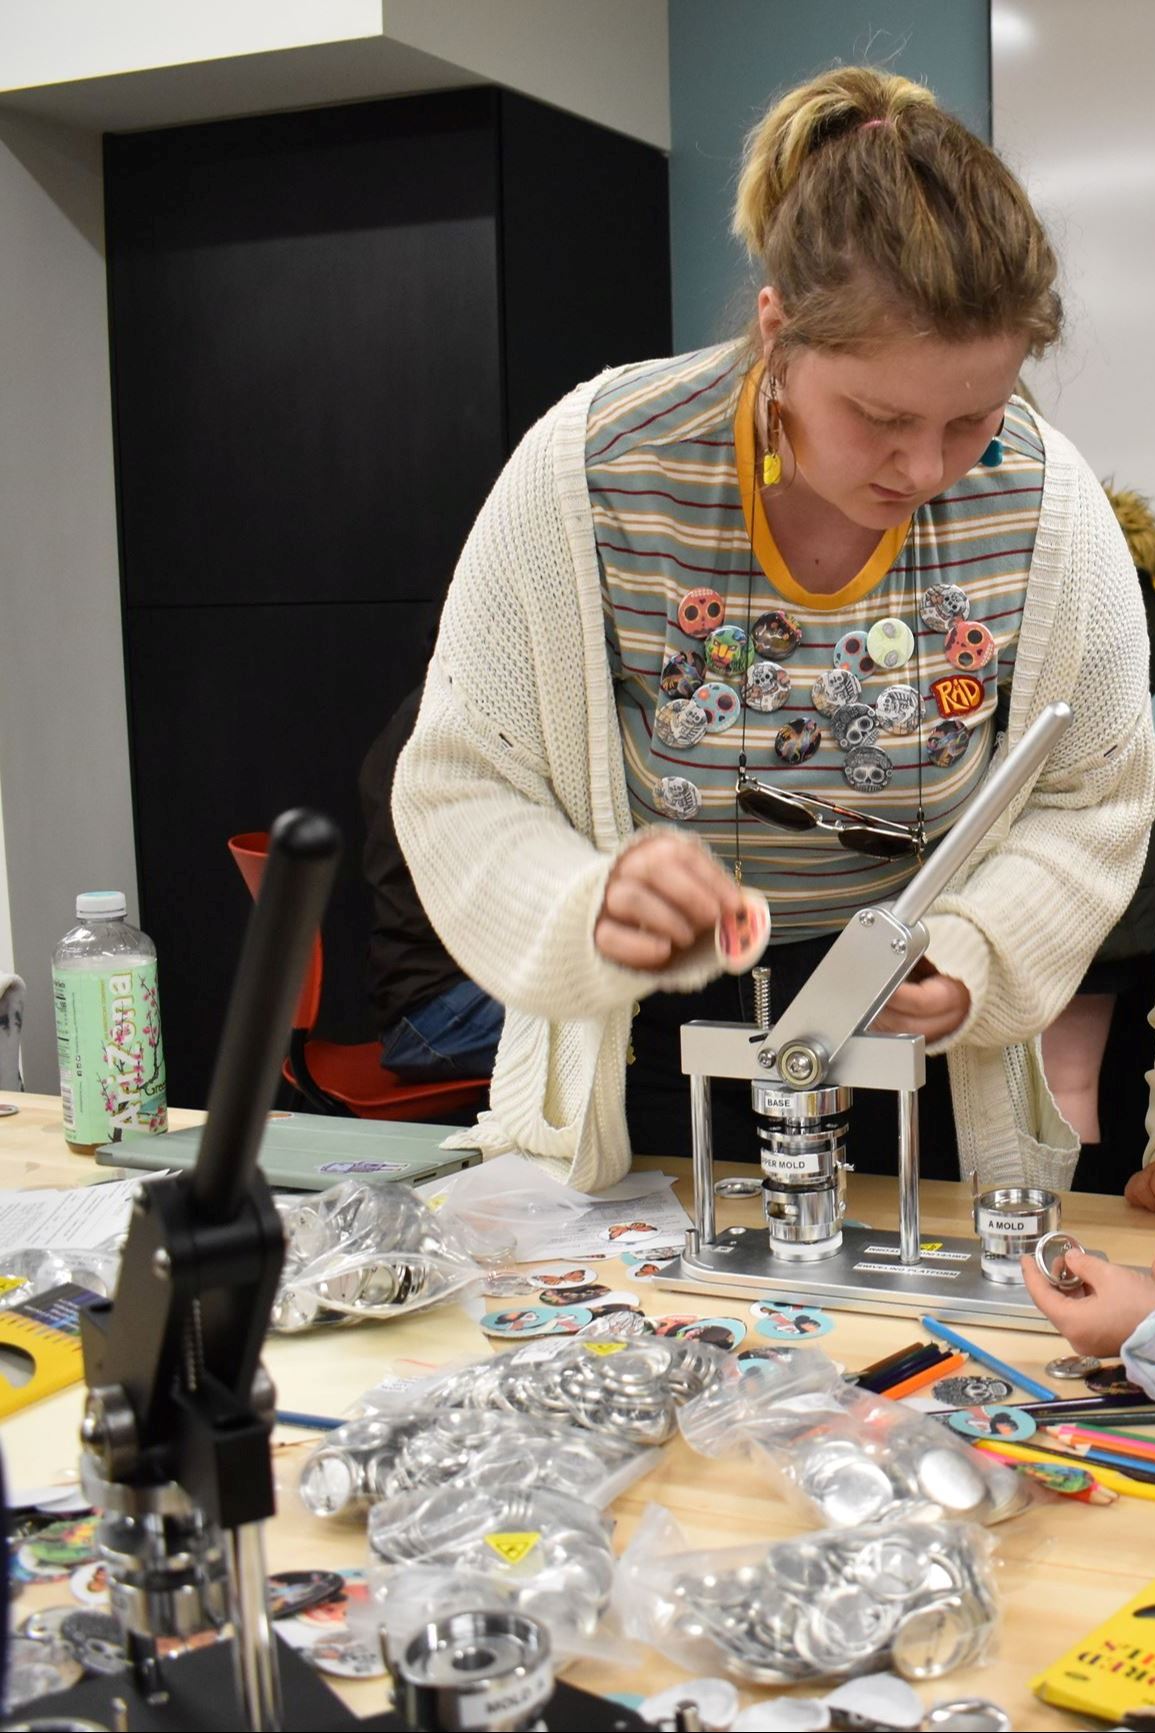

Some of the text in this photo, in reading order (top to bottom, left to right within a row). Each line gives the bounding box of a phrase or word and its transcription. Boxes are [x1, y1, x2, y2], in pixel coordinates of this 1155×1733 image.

[936, 679, 980, 714] RAD
[767, 1098, 790, 1107] BASE
[779, 1161, 805, 1169] MOLD
[988, 1220, 1024, 1230] A MOLD
[907, 1268, 958, 1277] PLATFORM
